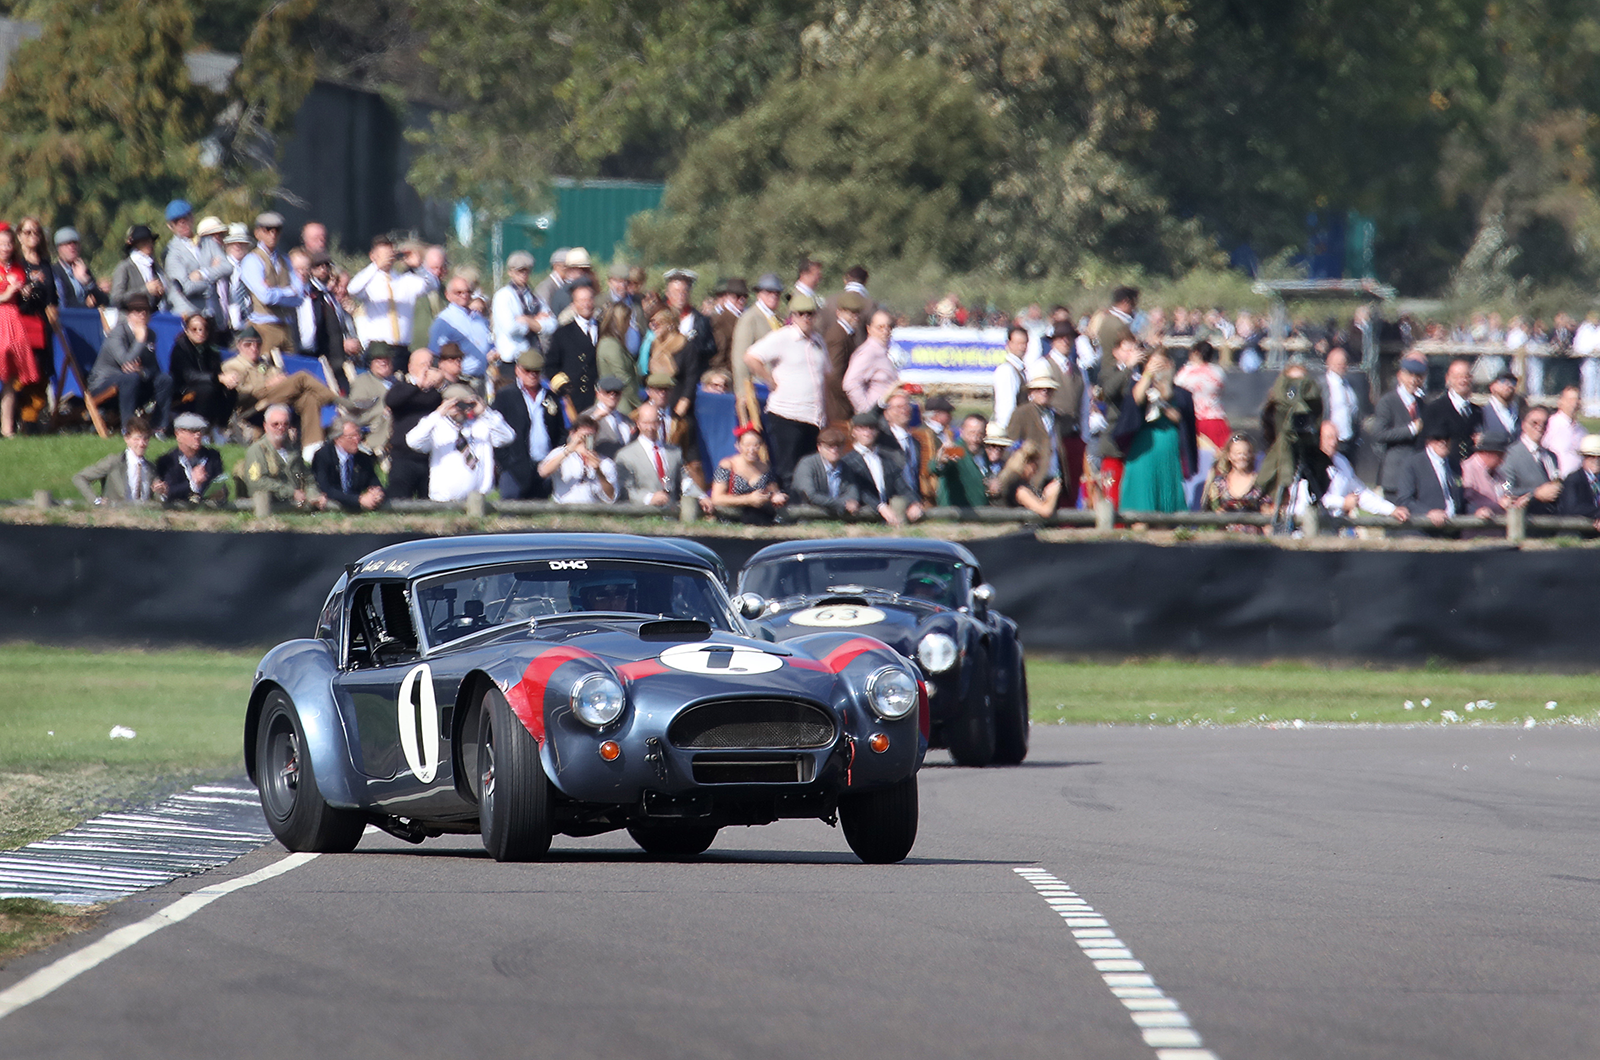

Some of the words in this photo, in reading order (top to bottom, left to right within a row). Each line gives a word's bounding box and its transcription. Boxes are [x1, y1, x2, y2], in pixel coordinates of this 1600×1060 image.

[548, 560, 588, 570] DHG
[815, 608, 859, 621] 63
[698, 645, 734, 669] 1
[410, 669, 427, 767] 1
